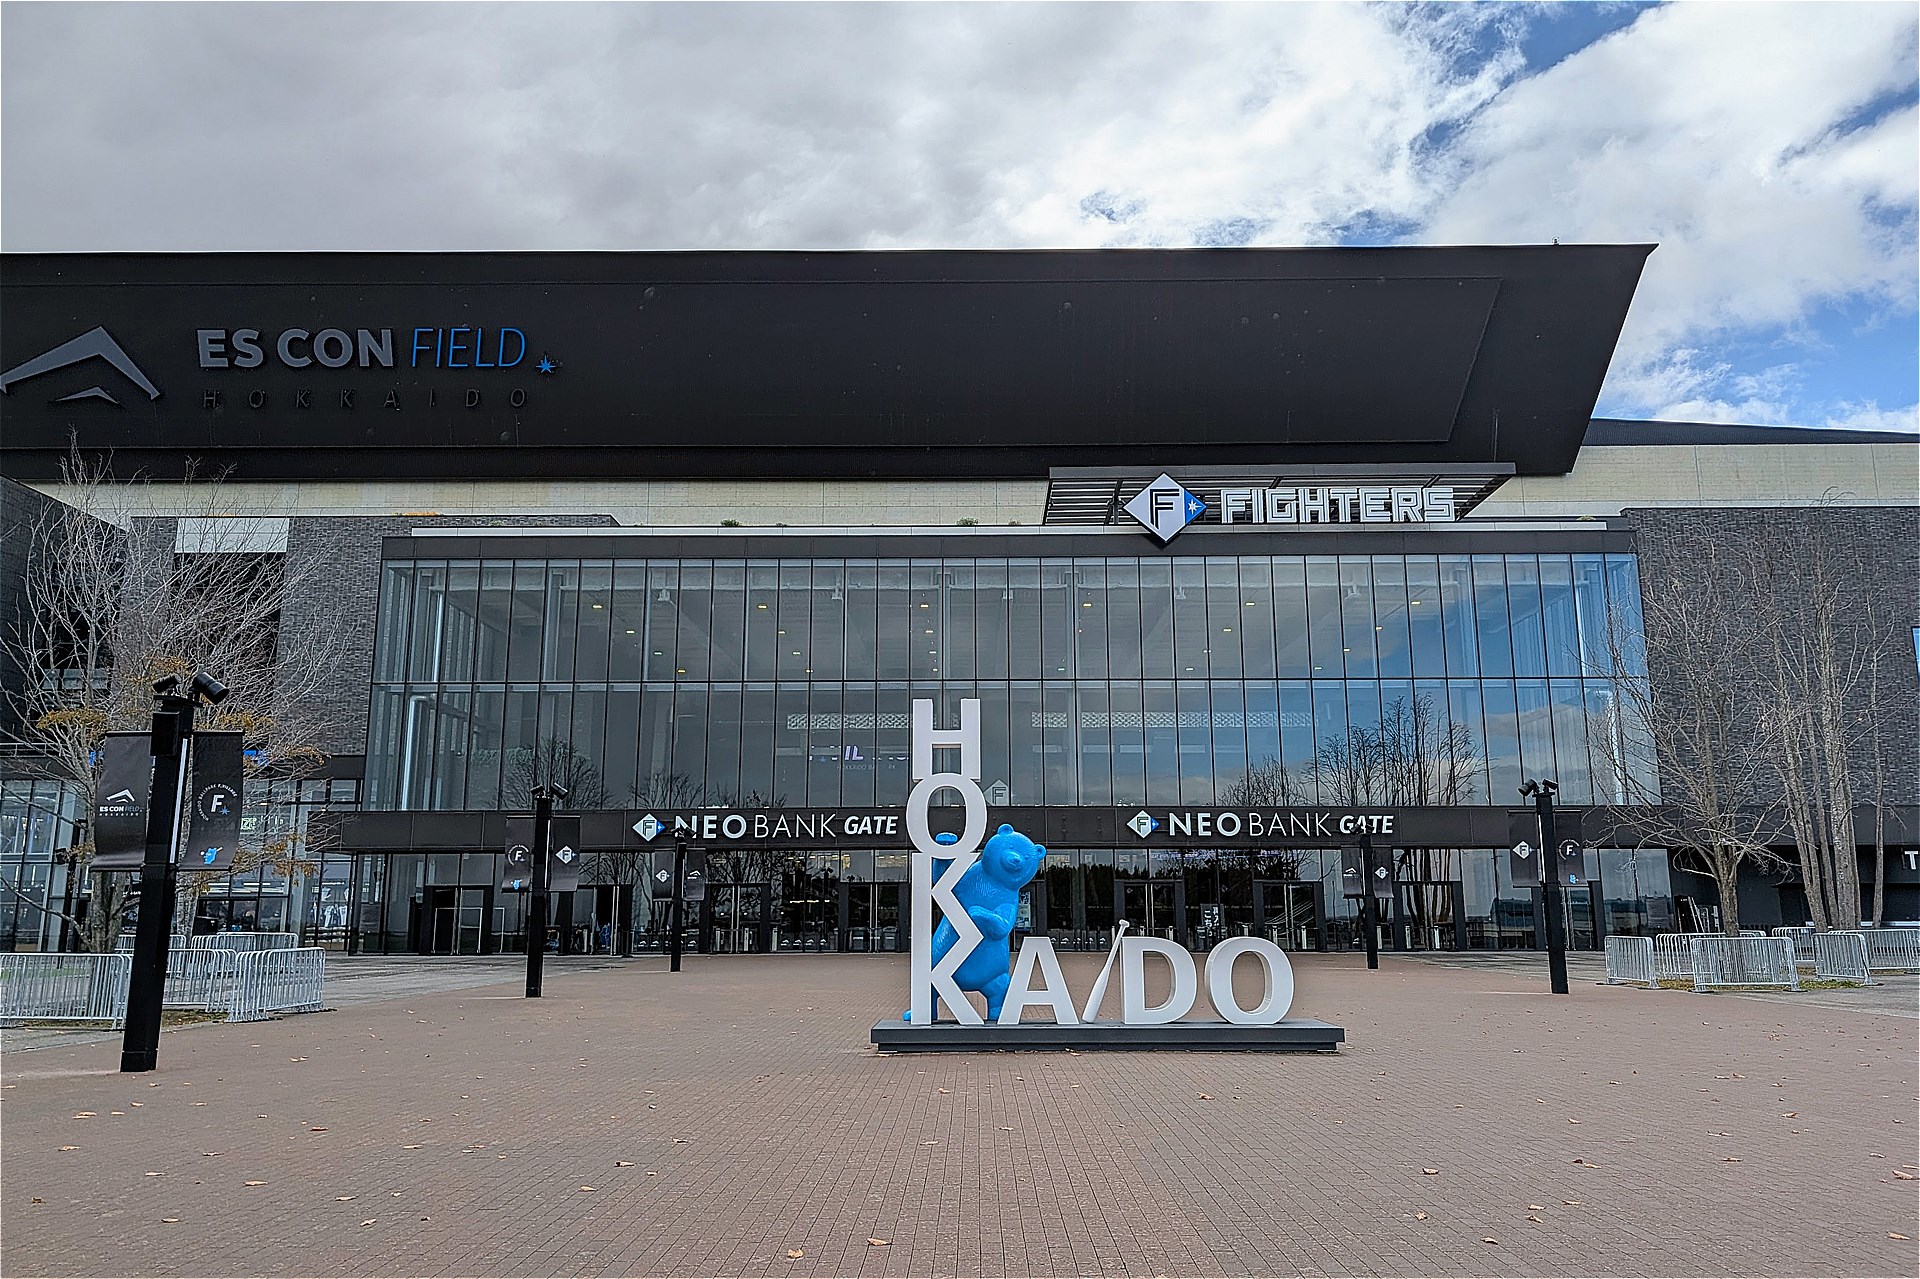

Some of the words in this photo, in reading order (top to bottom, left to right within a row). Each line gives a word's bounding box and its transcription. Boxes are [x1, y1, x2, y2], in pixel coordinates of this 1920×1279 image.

[197, 329, 264, 368] ES
[277, 329, 394, 368] CON
[412, 328, 526, 367] FIELD
[203, 389, 525, 408] HOKKAIDO
[1221, 488, 1454, 523] FIGHTERS
[210, 794, 225, 813] F
[844, 815, 899, 835] GATE
[1339, 815, 1394, 834] GATE
